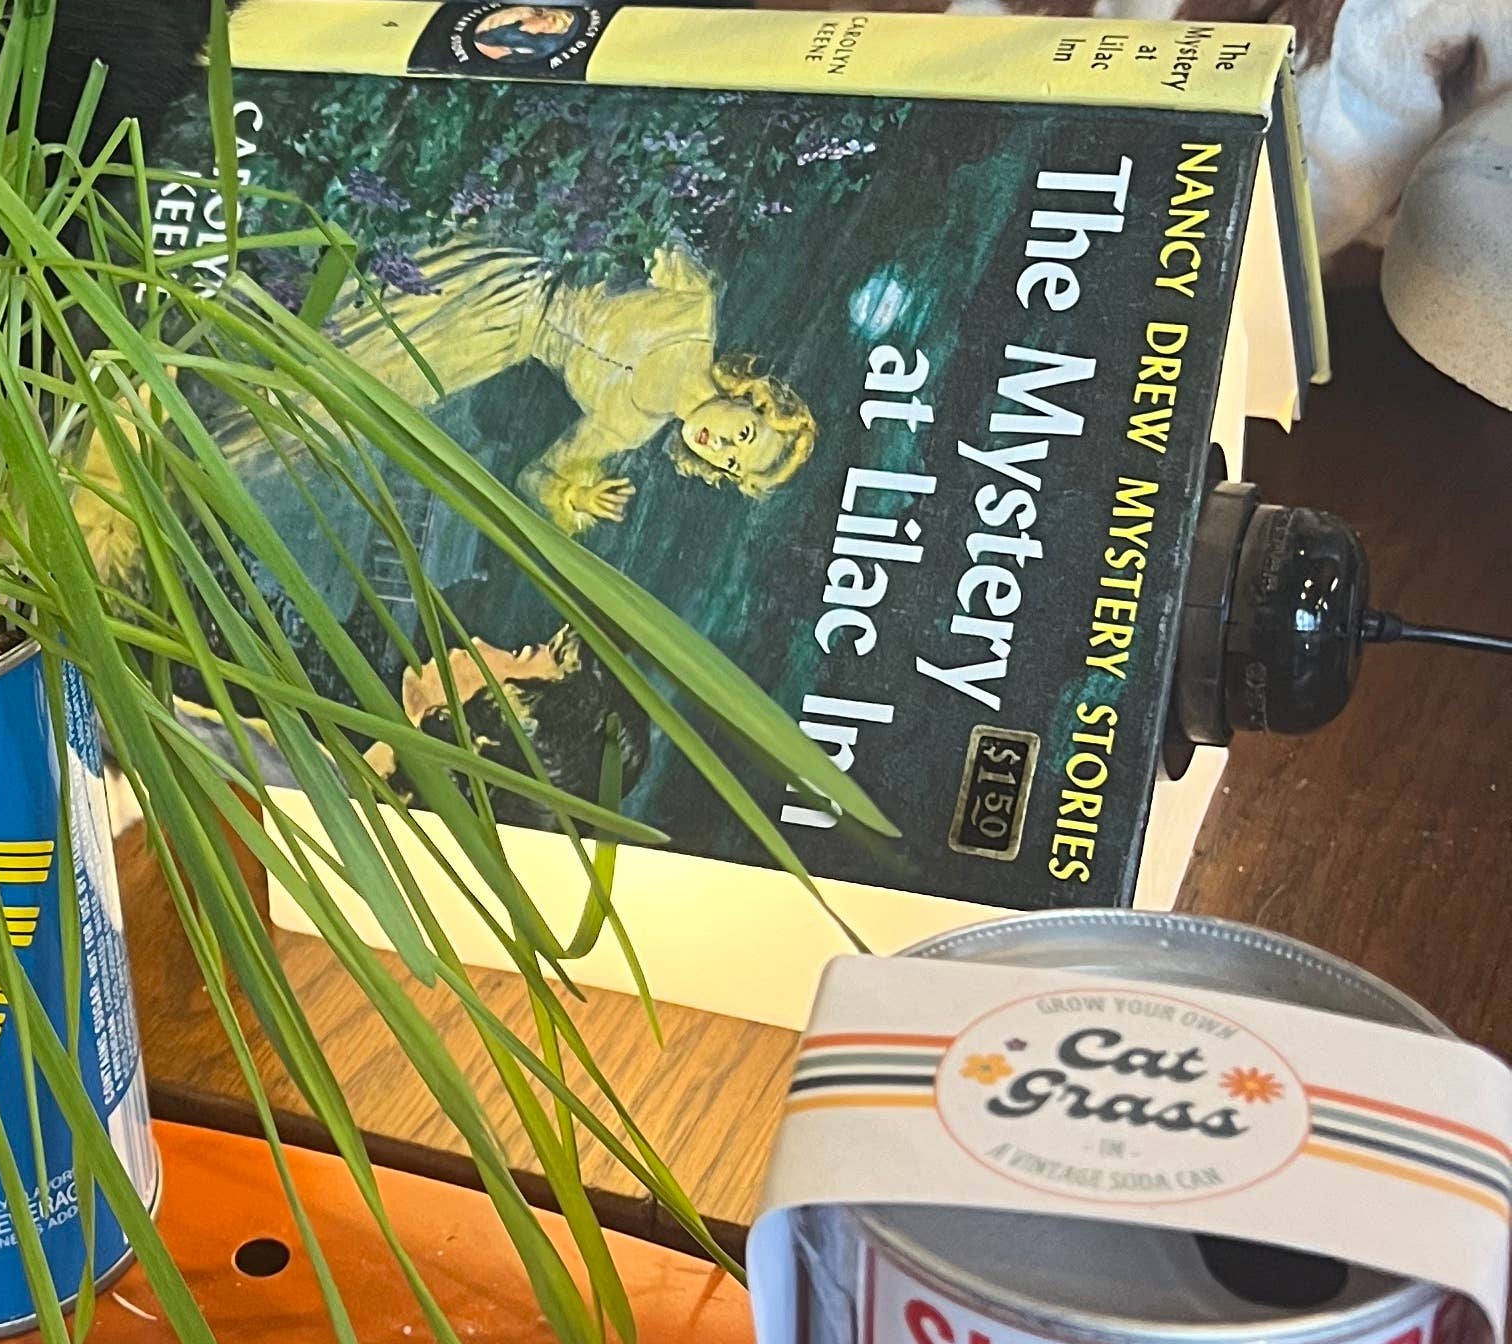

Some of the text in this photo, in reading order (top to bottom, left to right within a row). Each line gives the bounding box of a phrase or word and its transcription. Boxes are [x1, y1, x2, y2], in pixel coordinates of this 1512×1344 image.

[549, 40, 587, 70] DREW
[805, 22, 838, 62] KEENE
[827, 16, 868, 75] CAROLYN
[1053, 37, 1086, 62] Inn
[1091, 35, 1129, 71] Lilac
[1135, 44, 1157, 60] at
[1161, 26, 1215, 92] Mystery
[1216, 42, 1251, 71] The
[859, 344, 935, 432] at
[915, 155, 1133, 711] The Mystery
[1048, 143, 1222, 883] NANCY DREW MYSTERY STORIES
[814, 467, 937, 657] Lilac
[75, 873, 87, 895] BY
[78, 893, 91, 922] USE
[82, 921, 94, 950] FOR
[87, 949, 98, 977] NOT
[1037, 995, 1239, 1039] GROW YOUR OWN
[96, 1030, 115, 1105] CONTAINS
[1057, 1027, 1207, 1082] Cat
[986, 1068, 1250, 1138] Grass
[988, 1142, 1223, 1191] A VINTAGE SODA CAN
